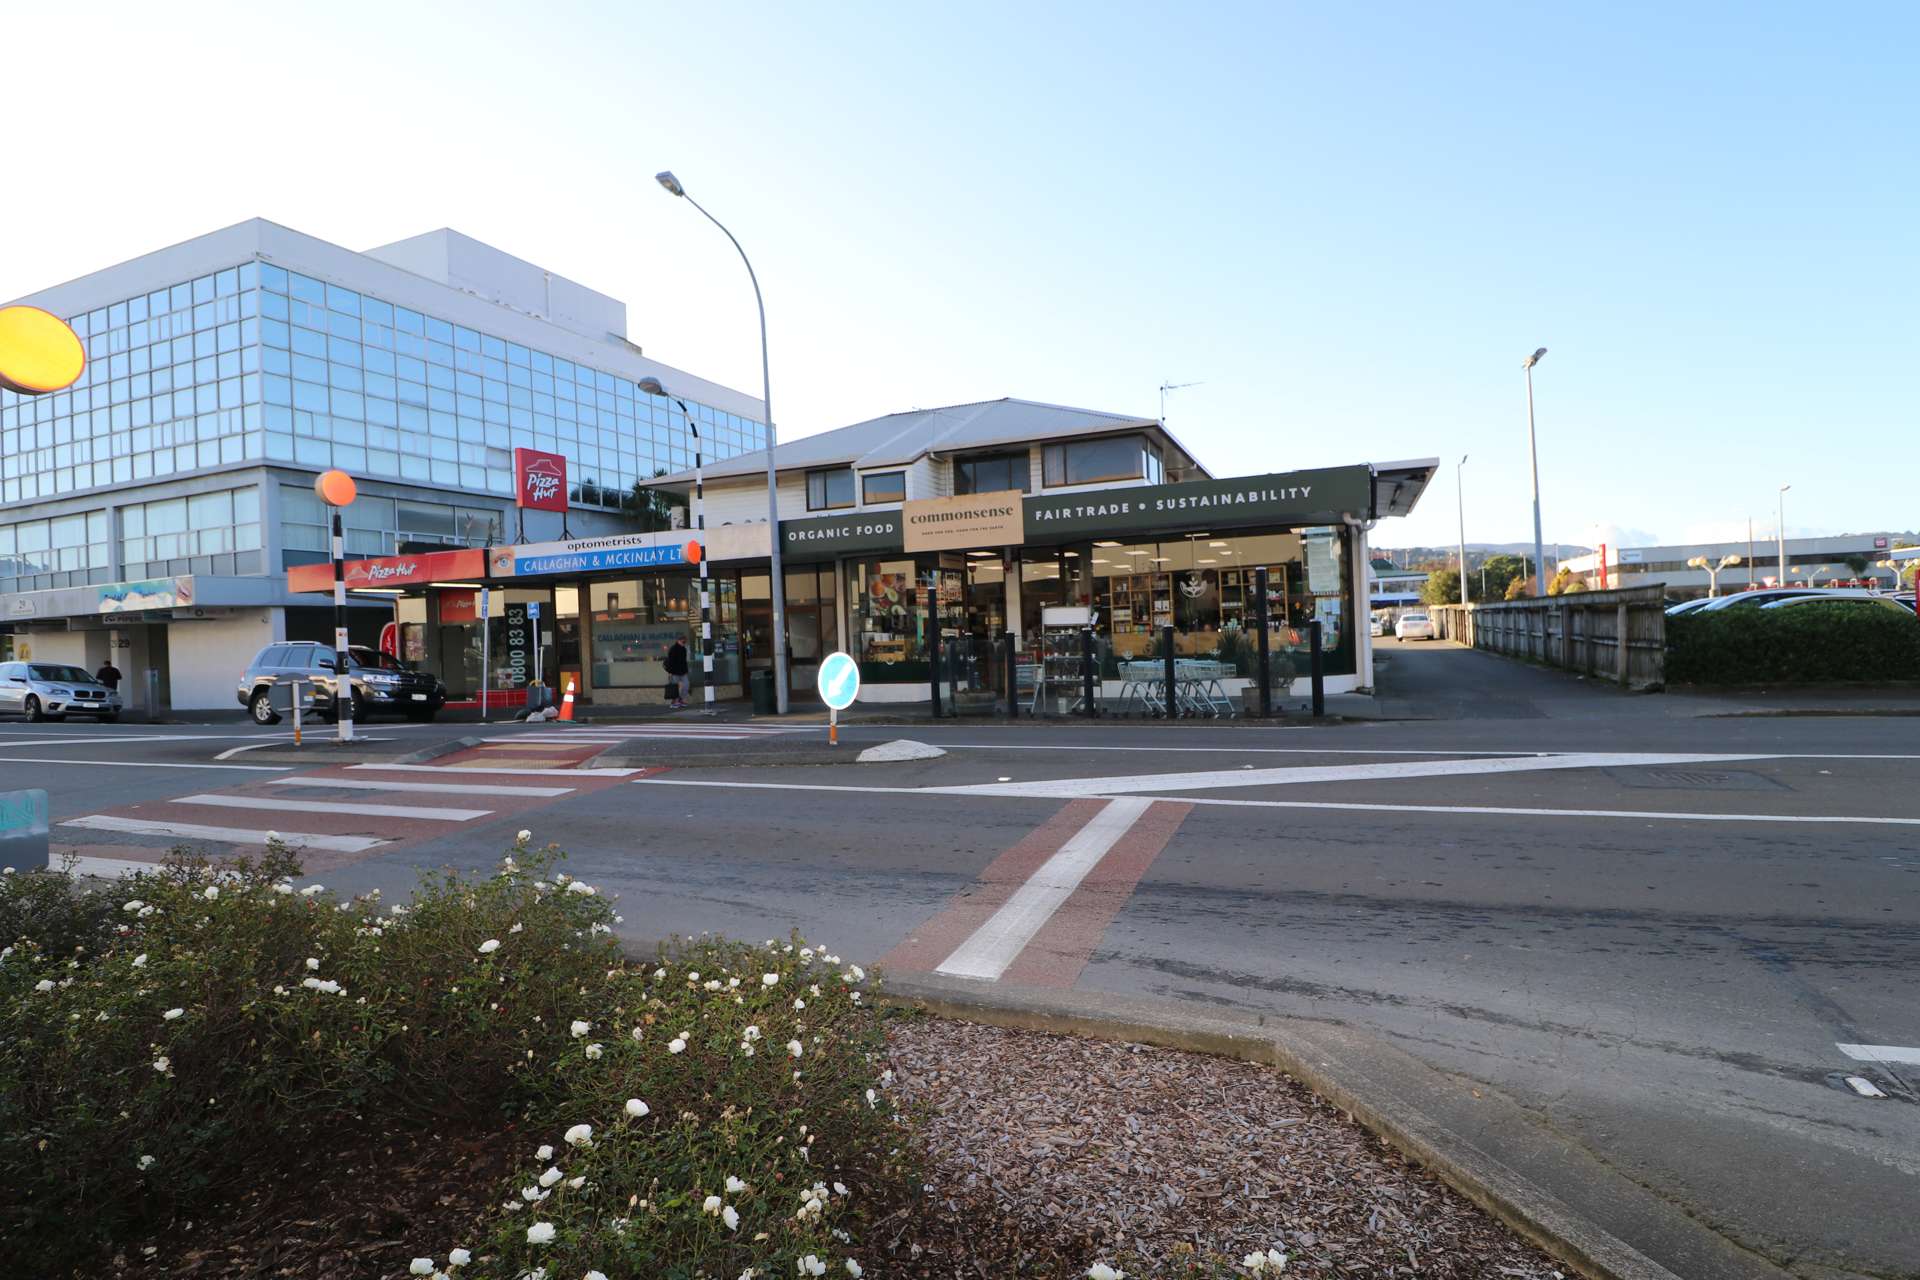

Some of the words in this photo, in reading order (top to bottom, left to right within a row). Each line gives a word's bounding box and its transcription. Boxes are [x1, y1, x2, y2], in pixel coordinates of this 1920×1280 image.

[527, 473, 560, 490] Pizza
[532, 486, 558, 501] Hut
[1156, 486, 1312, 511] SUSTAINABILITY
[910, 505, 1014, 525] commonsense
[788, 527, 850, 541] ORGANIC
[856, 523, 893, 536] FOOD
[567, 536, 642, 551] optometrists
[523, 556, 587, 572] CALLAGHAN
[592, 555, 600, 567] &
[605, 550, 665, 566] MCKINLAY
[368, 564, 396, 581] Pizza
[396, 563, 417, 577] Hut
[508, 608, 524, 625] 83
[509, 629, 525, 645] 83
[510, 650, 526, 683] 0800
